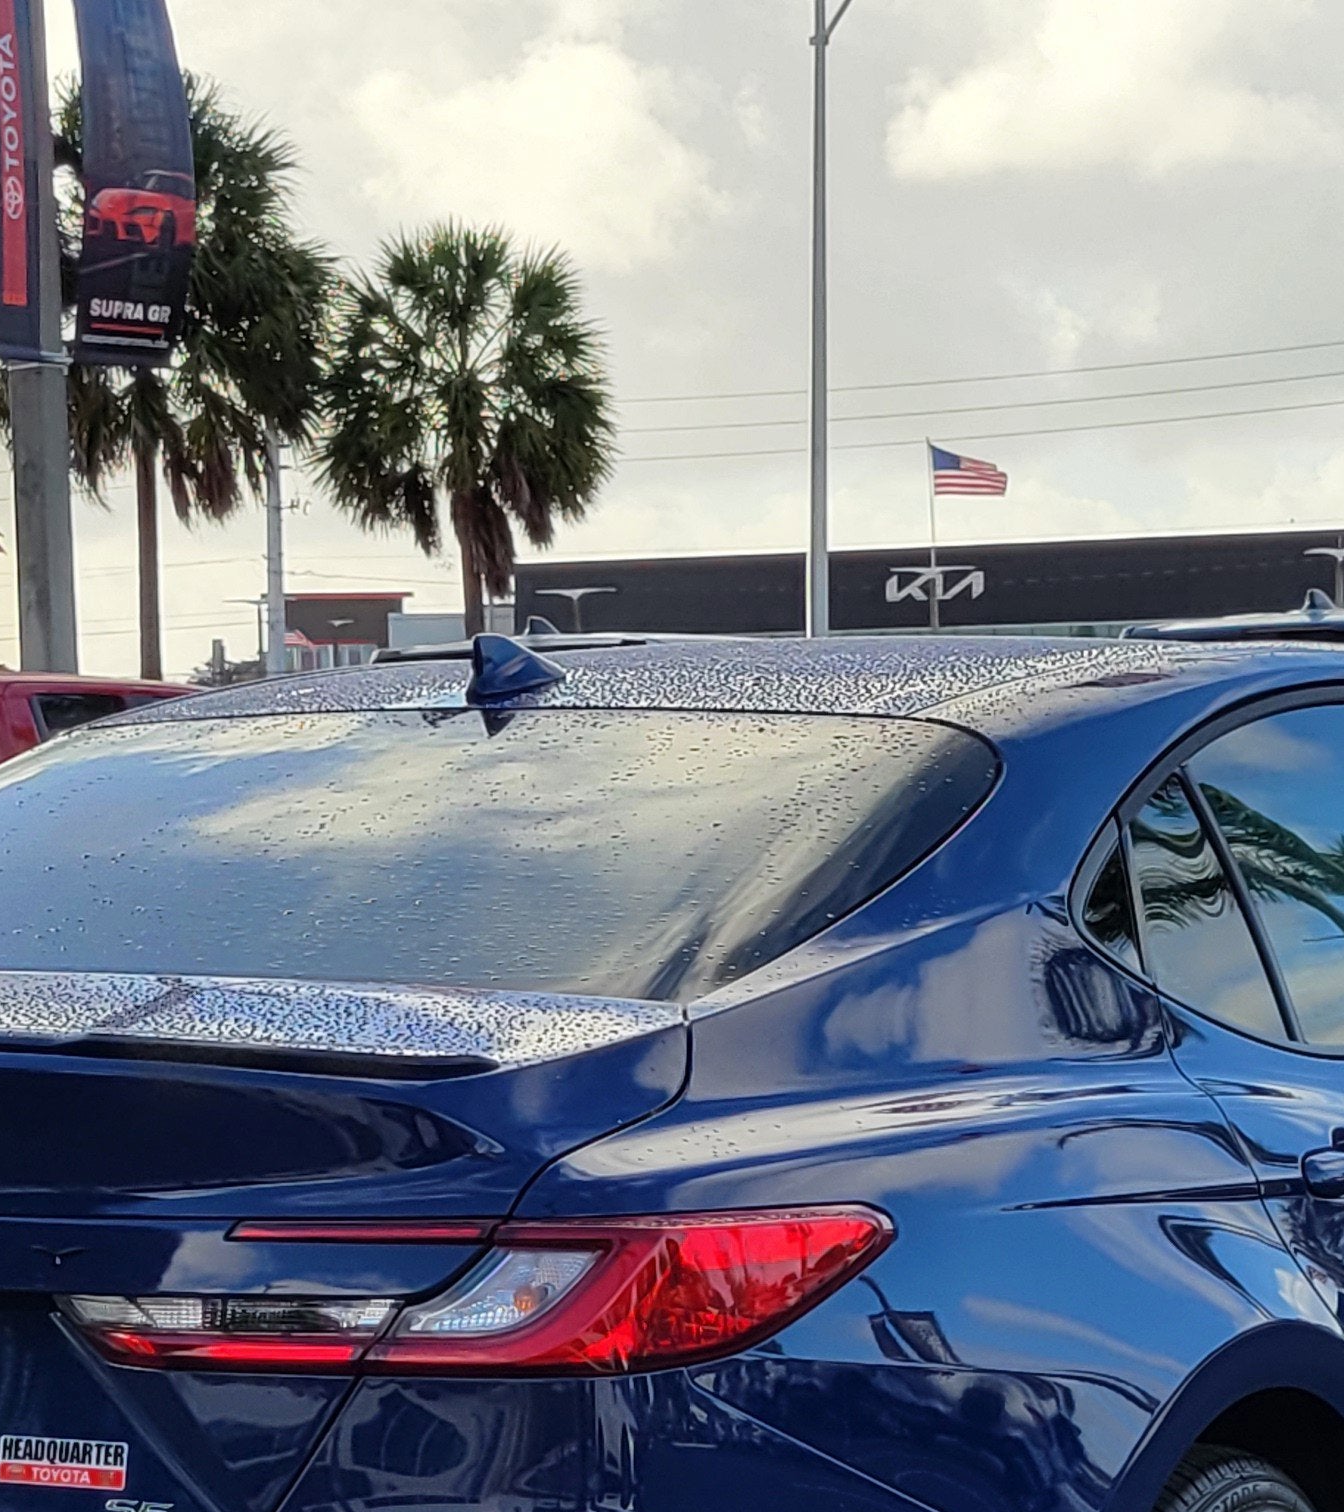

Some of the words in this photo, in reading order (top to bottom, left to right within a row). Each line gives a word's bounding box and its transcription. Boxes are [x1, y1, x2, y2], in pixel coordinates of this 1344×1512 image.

[89, 297, 144, 321] SUPRA
[147, 303, 172, 325] GR
[885, 569, 985, 602] KIA
[1, 1437, 125, 1467] HEADQUARTER
[31, 1466, 91, 1484] TOYOTA
